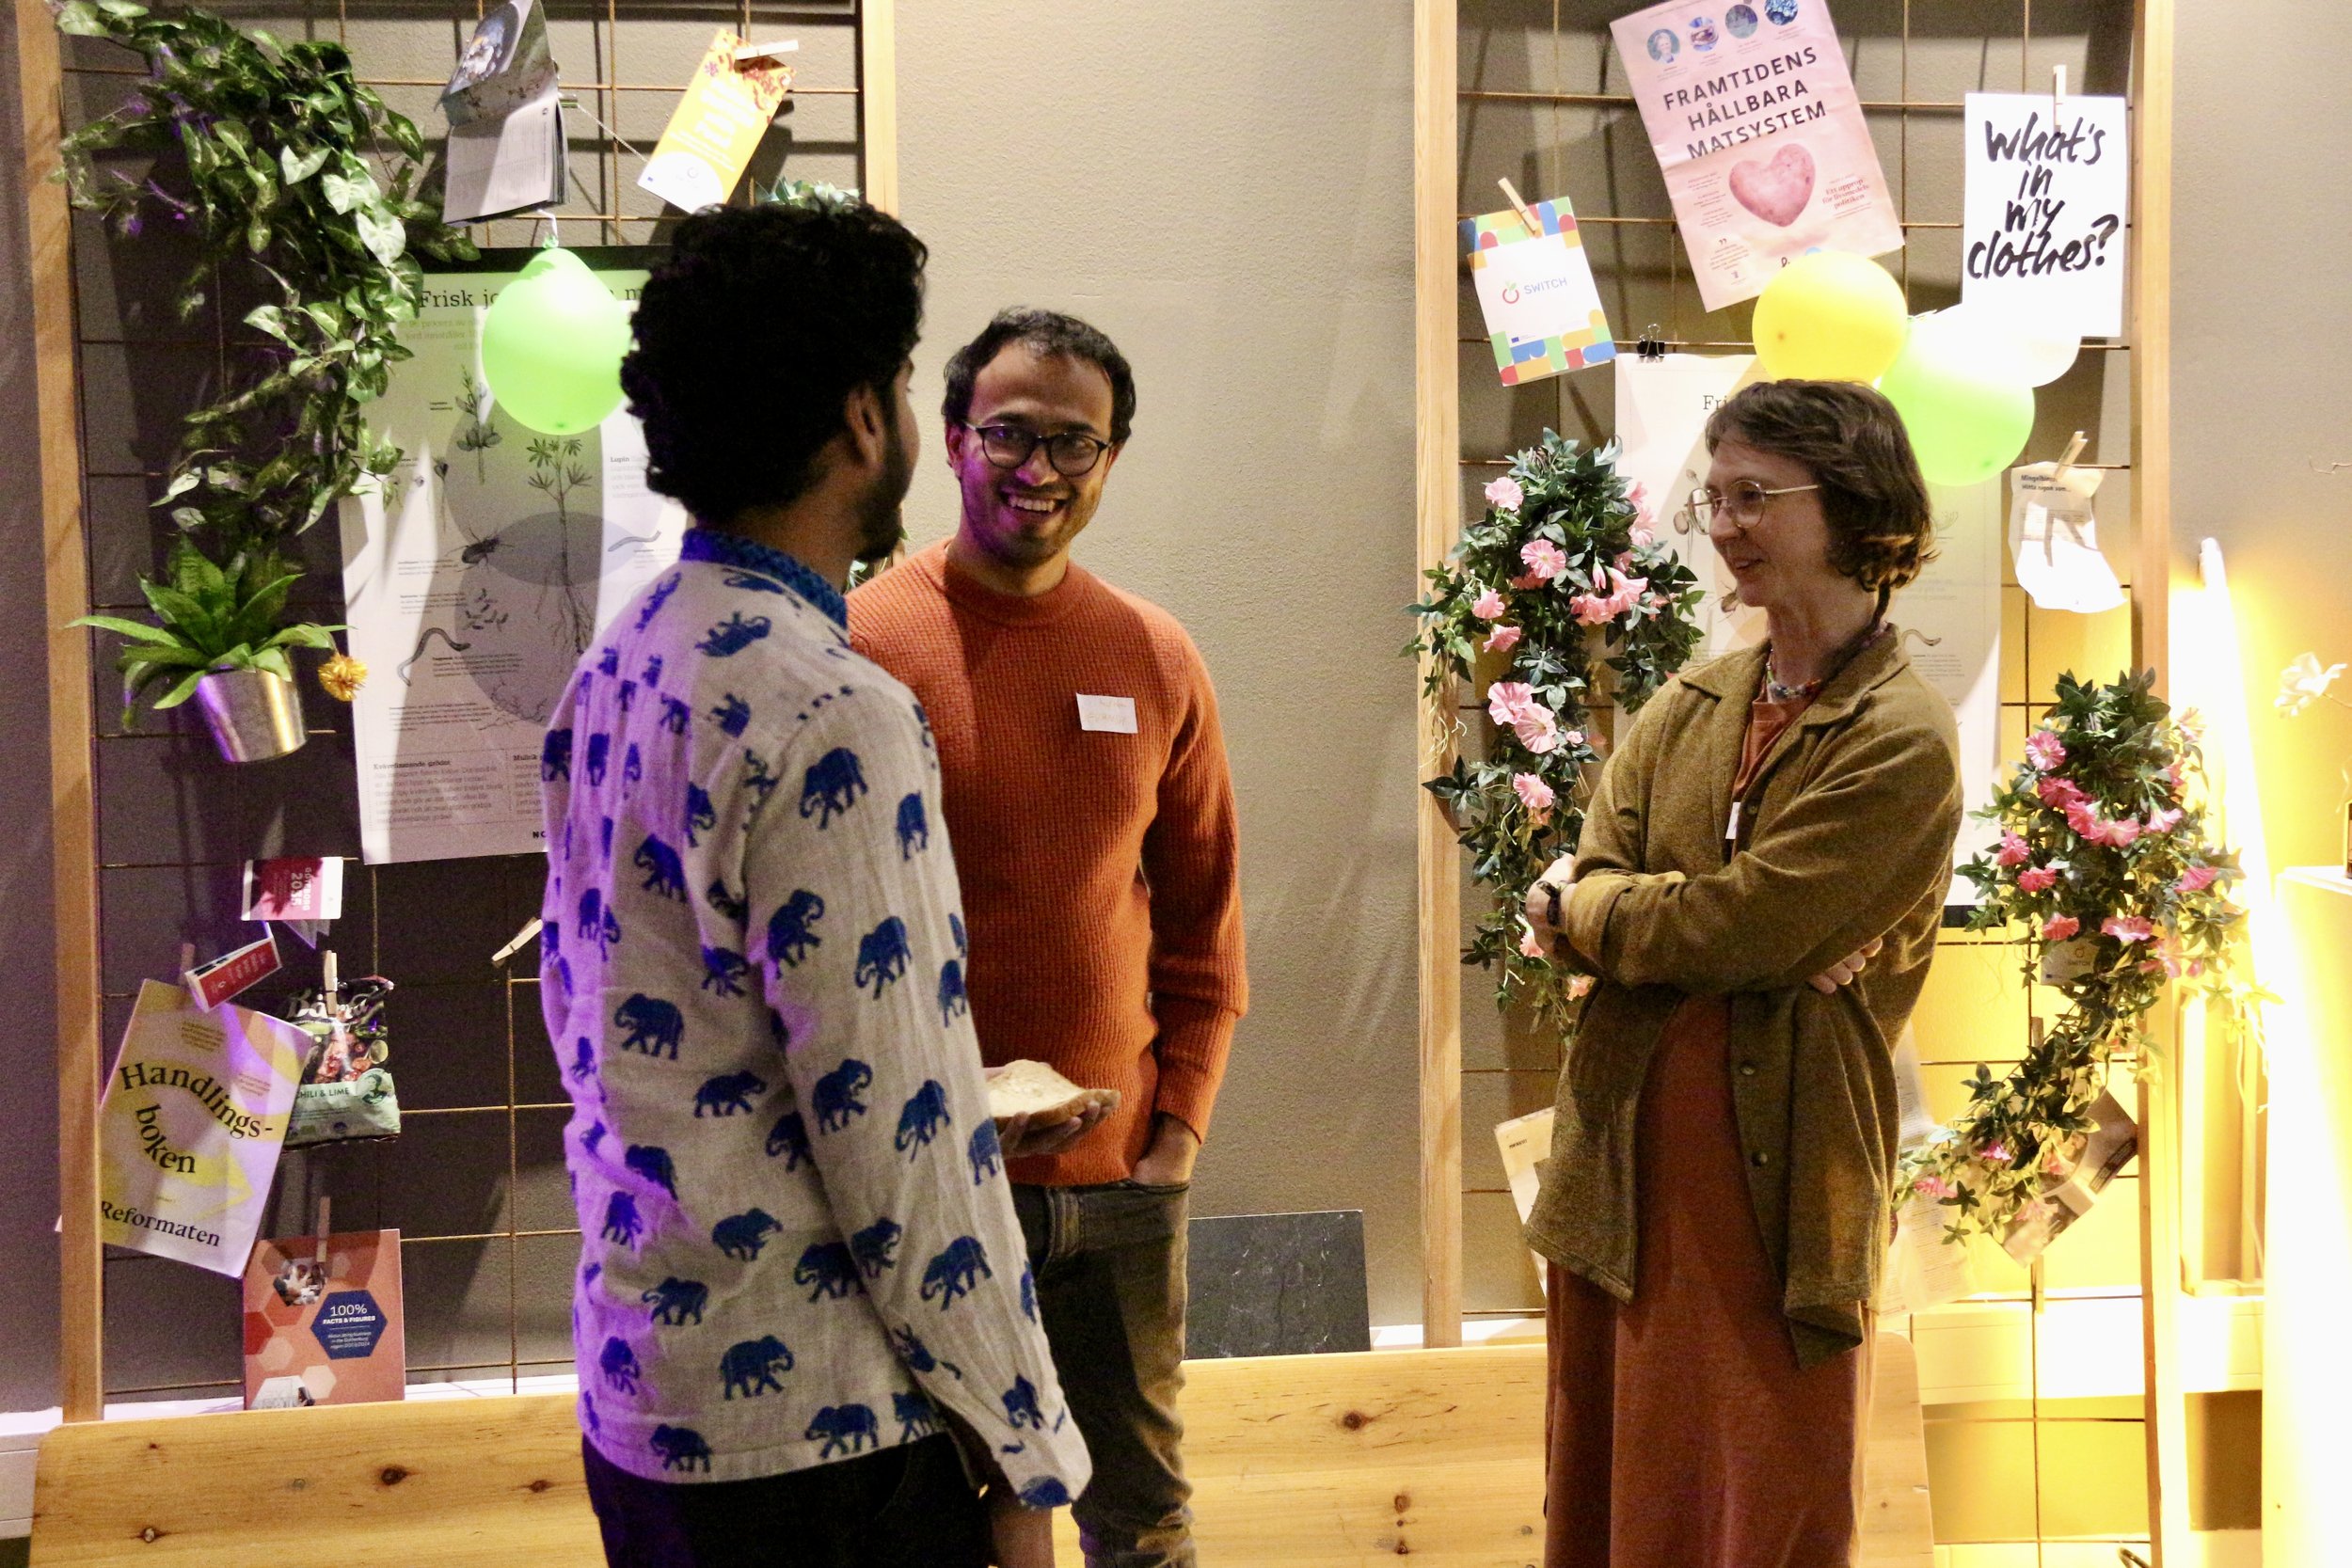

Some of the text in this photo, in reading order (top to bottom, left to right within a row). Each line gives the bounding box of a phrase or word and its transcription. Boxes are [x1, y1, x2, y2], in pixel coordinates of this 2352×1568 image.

[1663, 47, 1818, 111] FRAMTIDENS
[1688, 79, 1808, 132] HÅLLBARA
[1686, 101, 1826, 159] MATSYSTEM
[2018, 160, 2053, 200] in
[2005, 198, 2065, 238] my
[1967, 214, 2120, 279] clothes?
[420, 290, 473, 308] Frisk
[1523, 277, 1567, 294] SWITCH
[1703, 395, 1728, 410] Fri
[119, 1062, 273, 1139] Handlings-
[320, 1089, 326, 1098] &
[328, 1086, 350, 1097] LIME
[135, 1103, 196, 1174] boken
[101, 1200, 220, 1247] Reformaten
[329, 1304, 368, 1317] 100%
